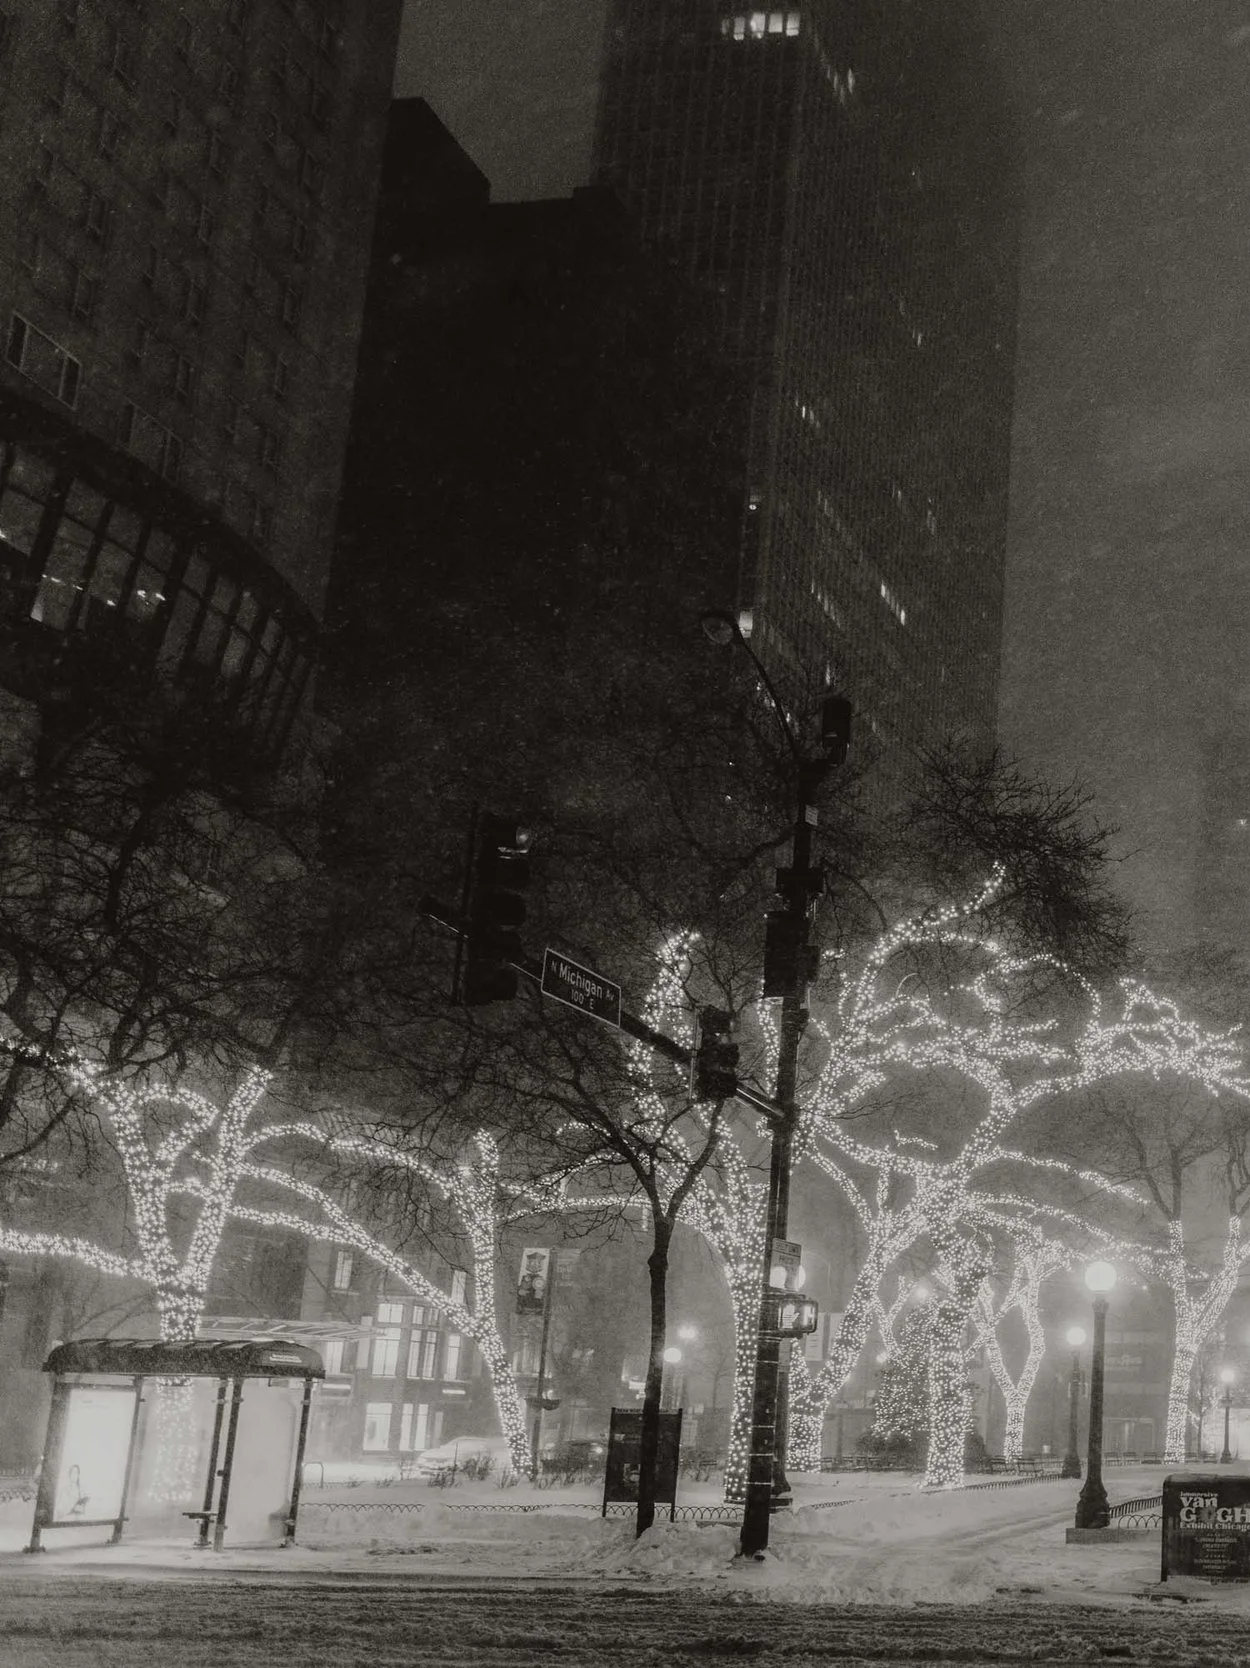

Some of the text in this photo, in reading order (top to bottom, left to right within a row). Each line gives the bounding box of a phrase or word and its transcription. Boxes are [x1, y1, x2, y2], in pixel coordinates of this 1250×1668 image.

[551, 960, 558, 974] N
[560, 962, 603, 999] Michigan
[571, 989, 594, 1010] 100 E
[1180, 1496, 1218, 1508] van
